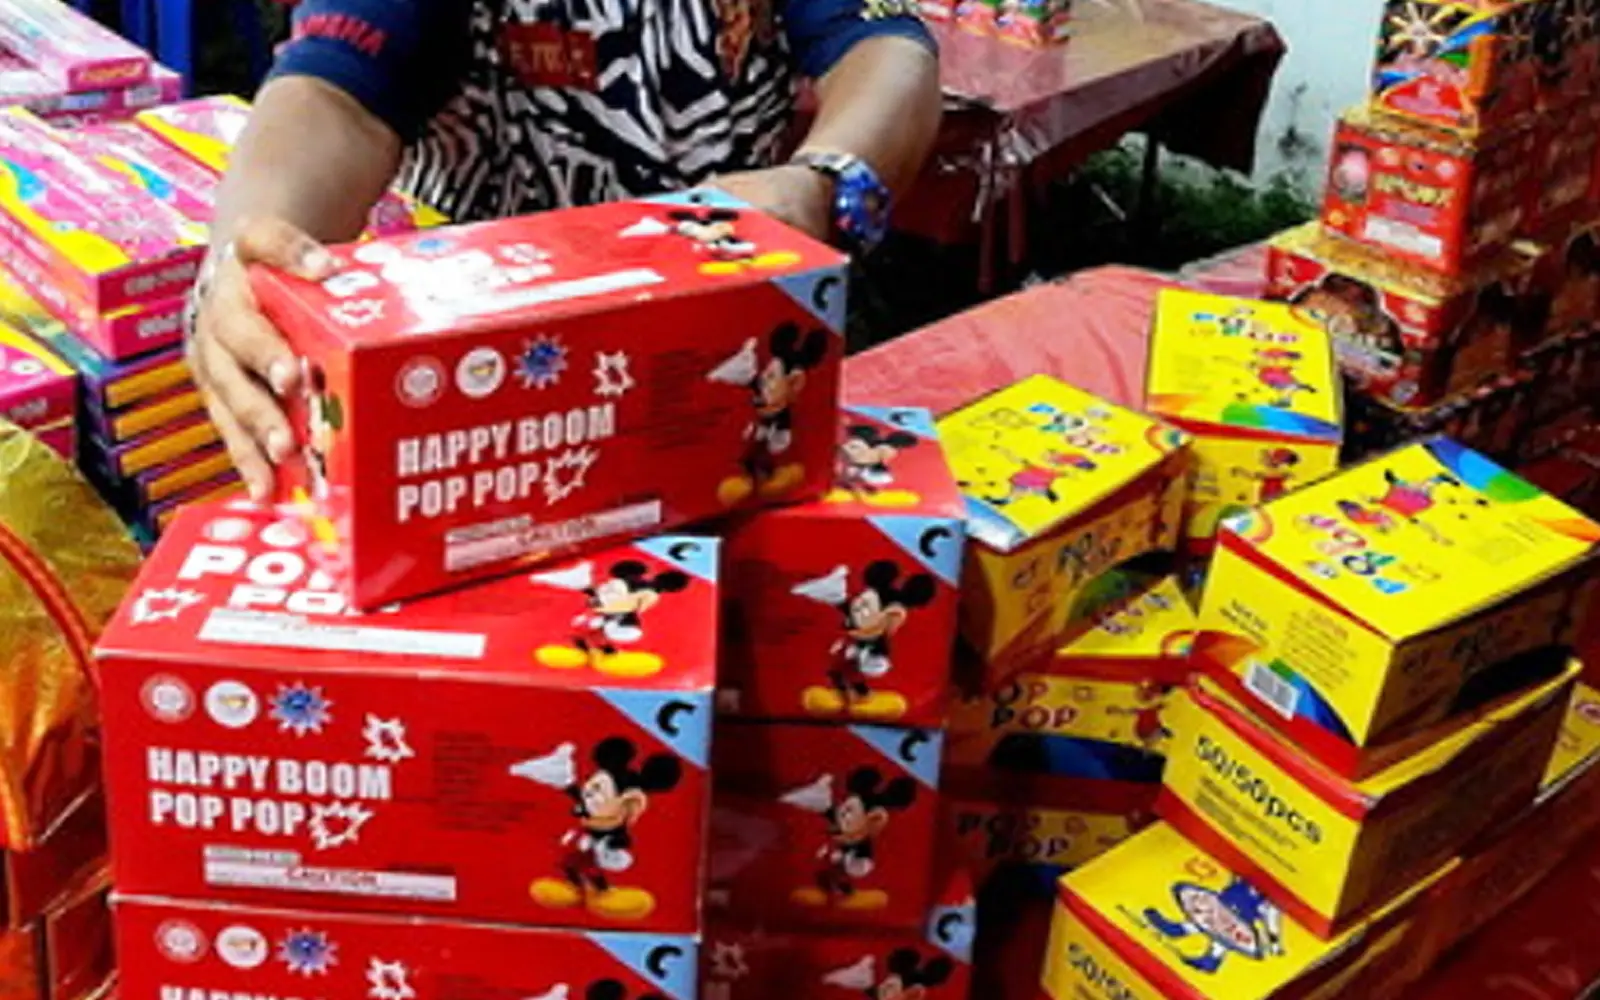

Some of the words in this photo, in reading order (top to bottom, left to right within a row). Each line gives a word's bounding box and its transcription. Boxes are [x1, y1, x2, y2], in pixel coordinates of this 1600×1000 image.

[396, 424, 511, 477] HAPPY
[516, 403, 614, 453] BOOM
[397, 477, 466, 522] POP
[473, 464, 540, 506] POP
[146, 747, 271, 791] HAPPY
[276, 759, 389, 799] BOOM
[1195, 733, 1322, 845] 50/50pcs
[149, 790, 226, 830] POP
[230, 798, 306, 835] POP
